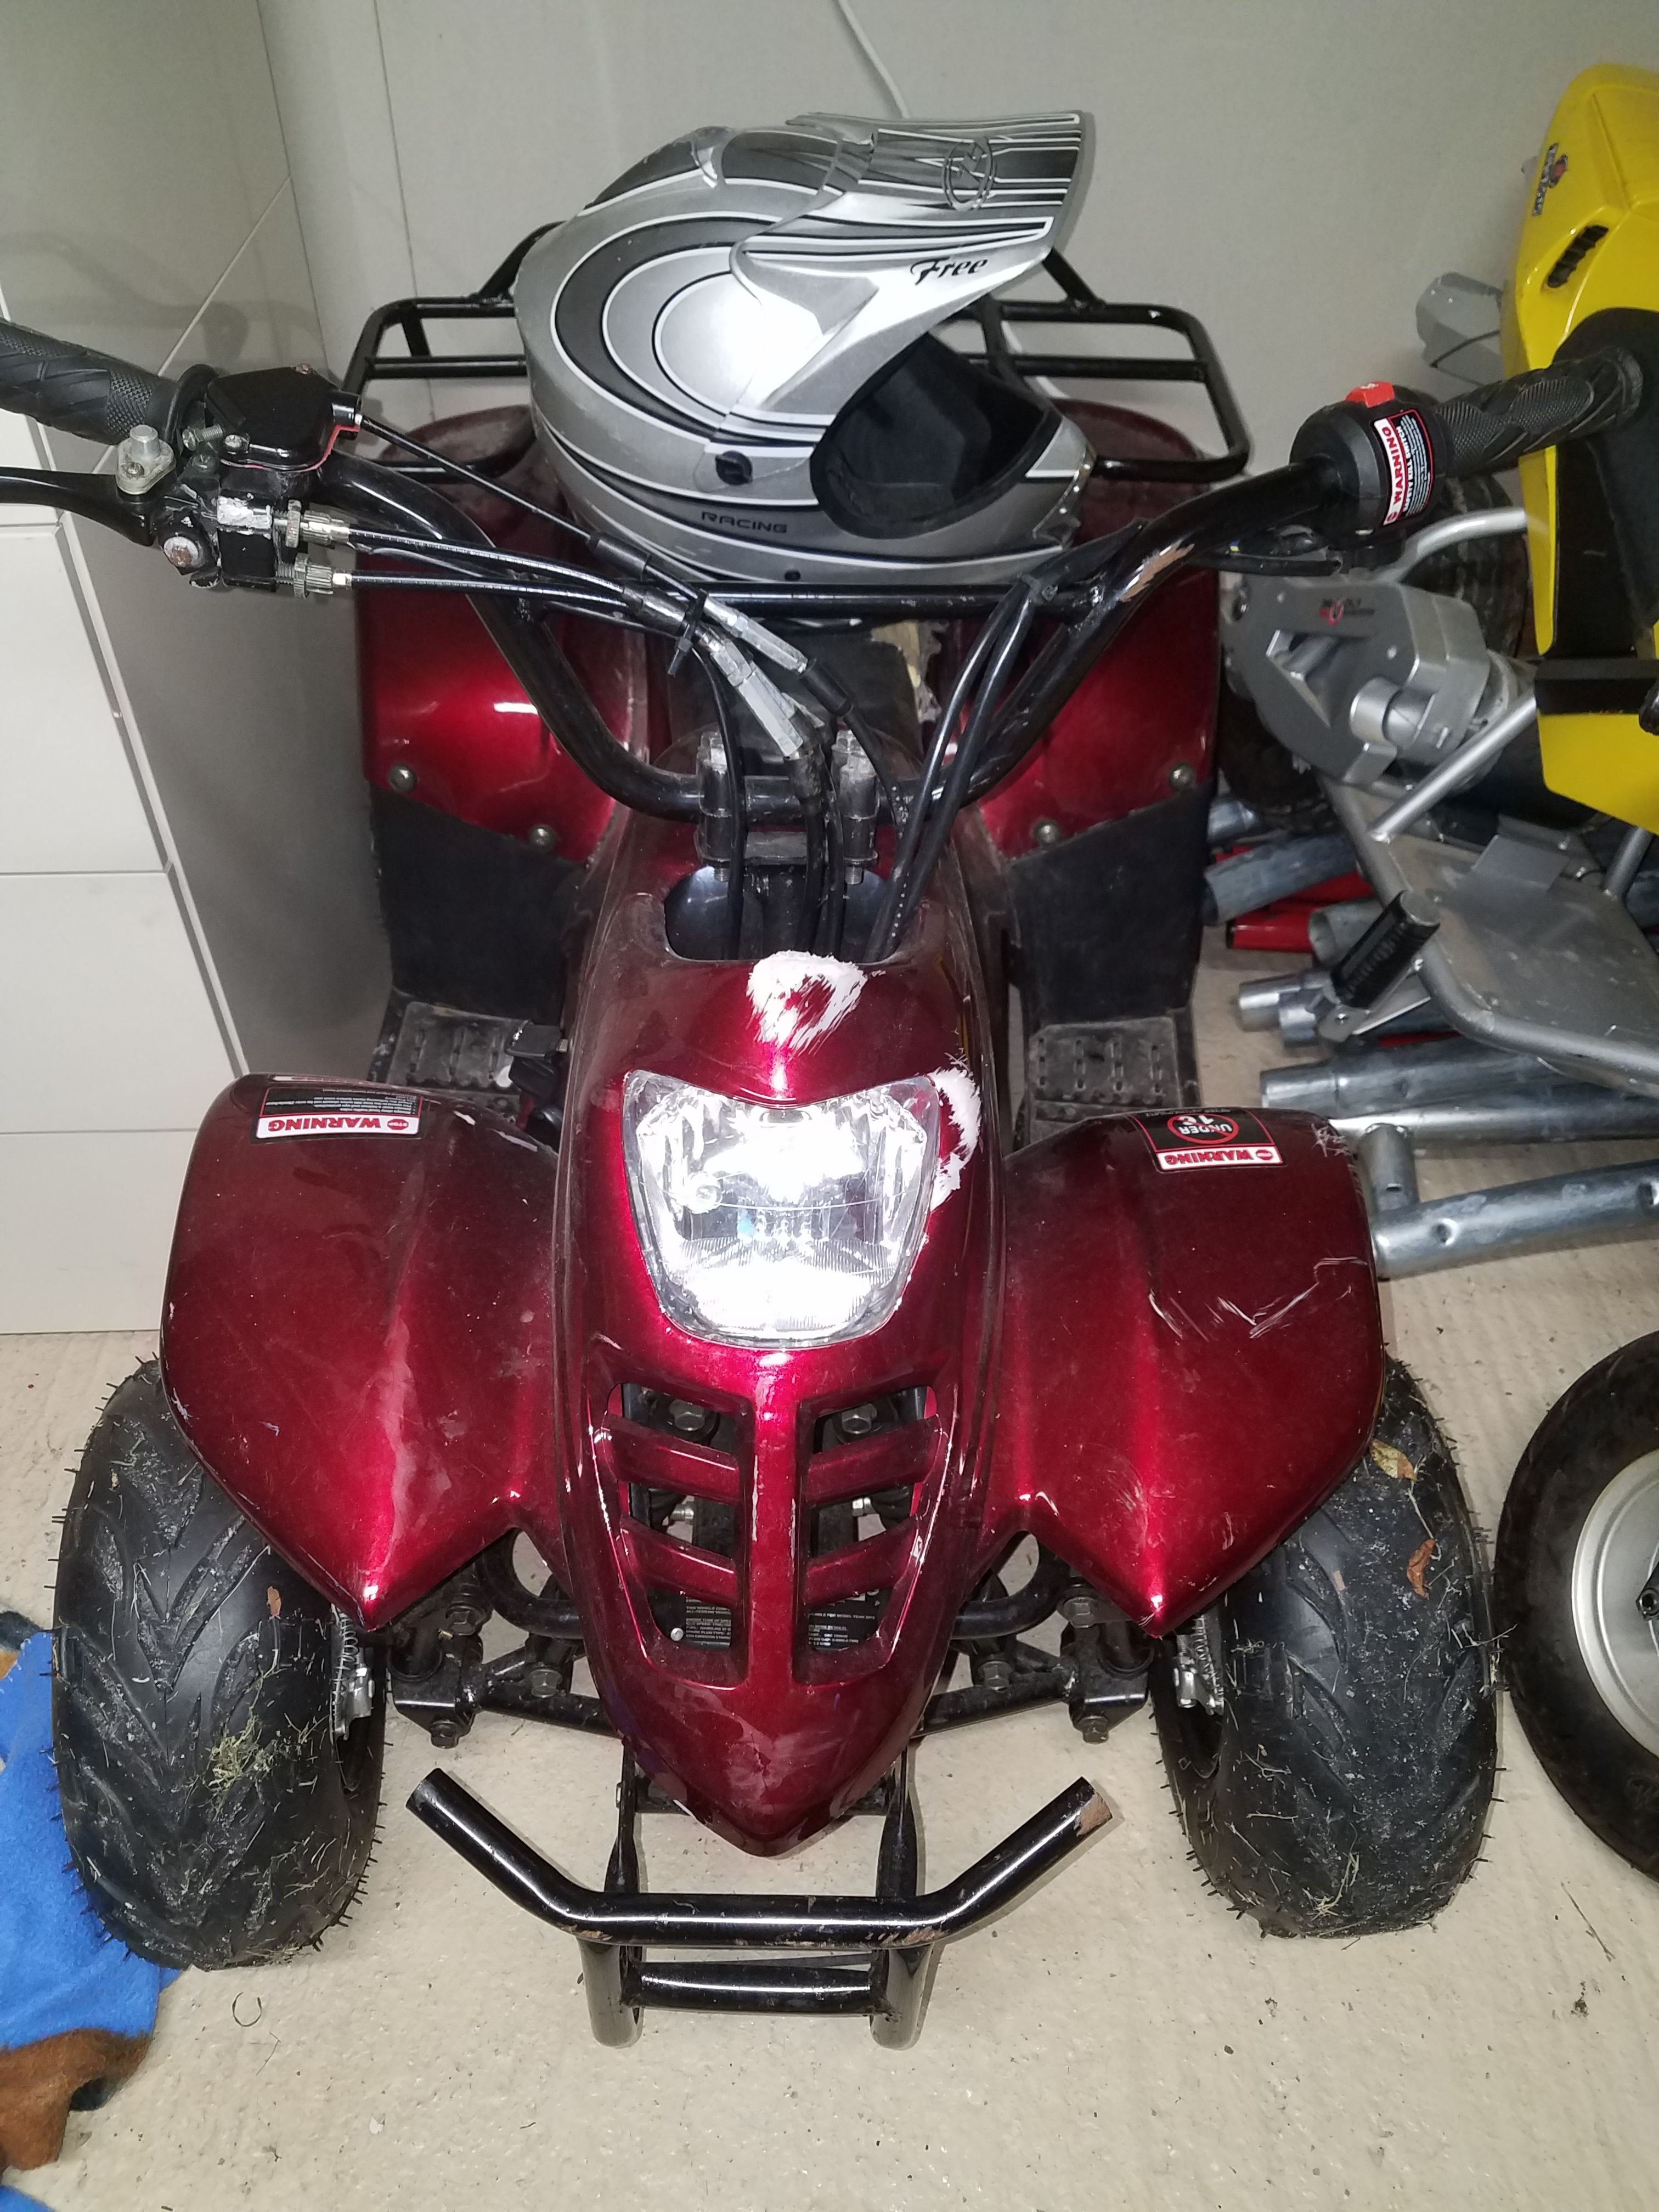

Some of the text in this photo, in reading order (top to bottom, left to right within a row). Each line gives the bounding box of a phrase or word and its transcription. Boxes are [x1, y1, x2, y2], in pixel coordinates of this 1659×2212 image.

[910, 256, 988, 285] Free
[1396, 425, 1412, 459] SWITCH
[1381, 426, 1404, 505] WARNING
[1403, 481, 1414, 513] SAFETY
[701, 511, 788, 533] RACING
[268, 1118, 381, 1132] WARNING
[1178, 1123, 1233, 1135] UNDER
[1165, 1150, 1254, 1165] WARNING
